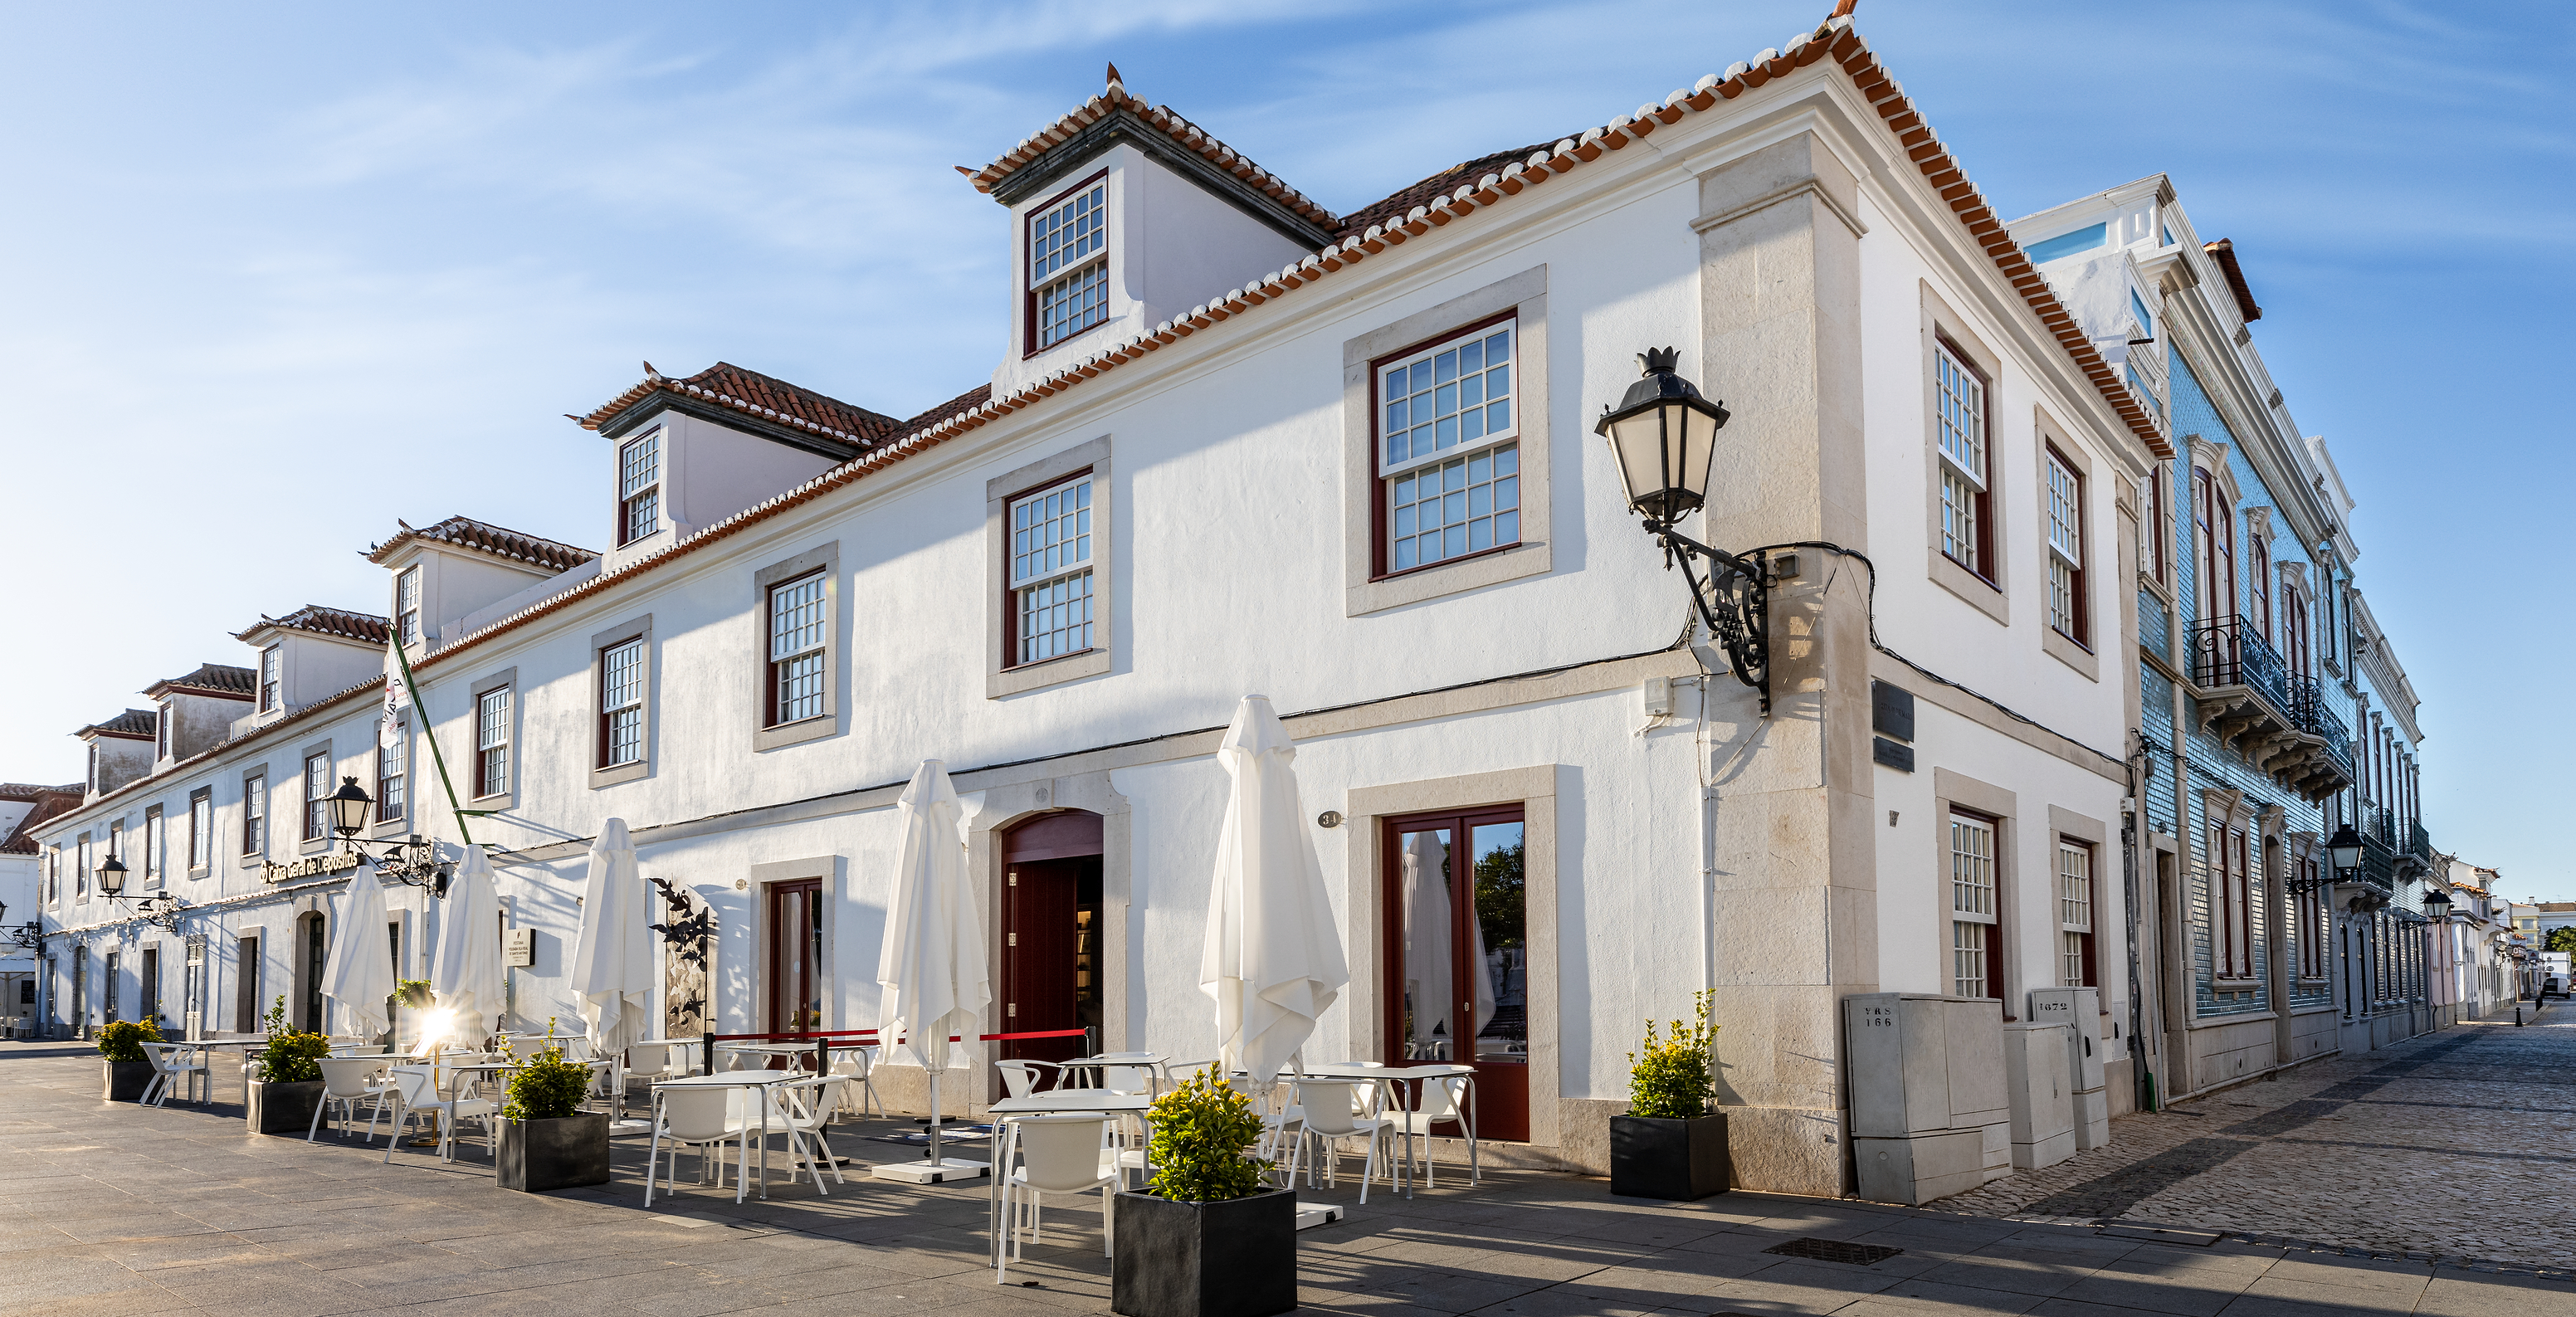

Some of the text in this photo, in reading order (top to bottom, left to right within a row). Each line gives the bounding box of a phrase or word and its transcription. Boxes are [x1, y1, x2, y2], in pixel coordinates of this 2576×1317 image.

[269, 865, 286, 882] Caixa
[287, 859, 305, 879] Geral
[306, 858, 316, 875] de
[1866, 1017, 1891, 1027] 166
